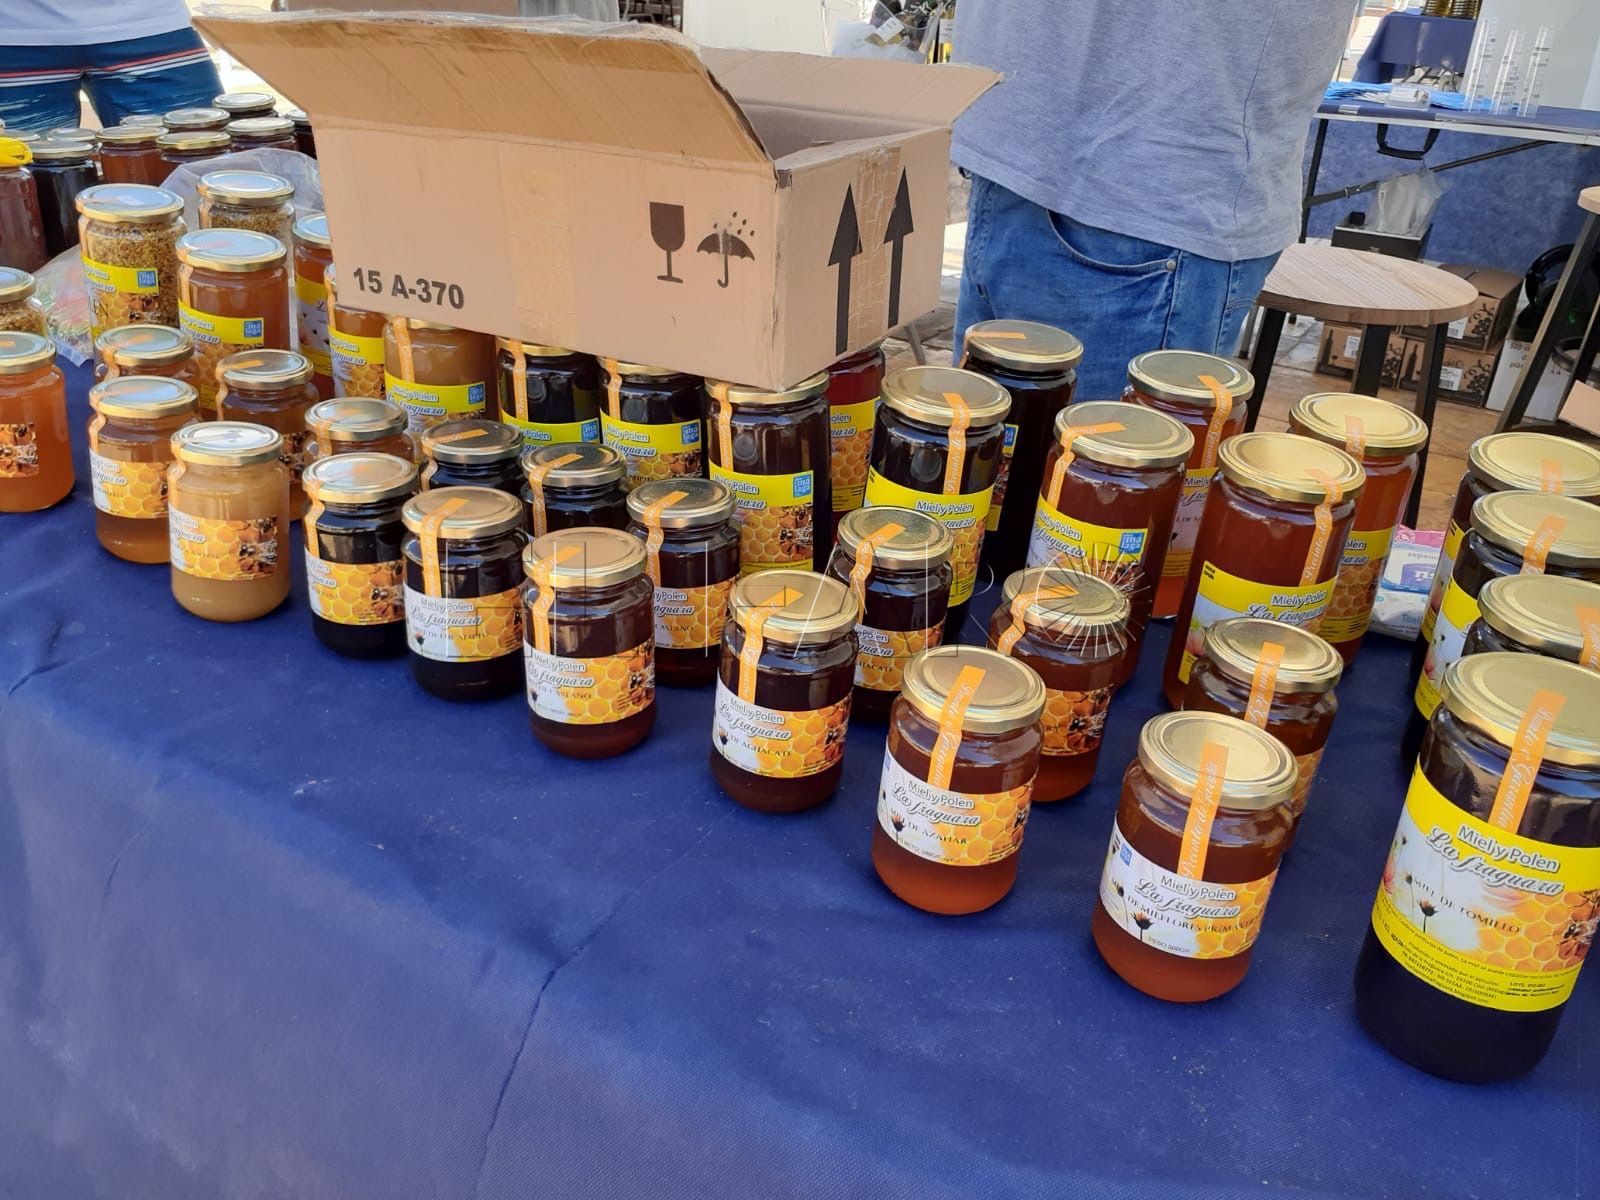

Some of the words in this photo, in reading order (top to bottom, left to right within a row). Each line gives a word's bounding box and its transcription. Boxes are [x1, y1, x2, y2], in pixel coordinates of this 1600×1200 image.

[353, 267, 383, 294] 15
[391, 274, 465, 310] A-370
[413, 393, 438, 402] Polen
[831, 414, 850, 423] olen
[526, 430, 550, 440] Polen
[624, 432, 649, 443] Polen
[1185, 477, 1202, 486] Miel
[733, 483, 758, 494] Polen
[917, 501, 938, 511] Miel
[949, 504, 972, 514] Polen
[1056, 521, 1080, 540] Polen
[1344, 541, 1365, 549] olen
[662, 592, 687, 601] Polen
[1272, 595, 1295, 606] Miel
[447, 602, 473, 612] Polen
[654, 606, 694, 617] aguara
[559, 660, 585, 672] Polen
[538, 671, 594, 689] fraguara
[755, 711, 783, 724] Polen
[731, 717, 790, 740] fraguara
[909, 780, 931, 798] Miel
[941, 794, 973, 809] Polen
[892, 782, 911, 807] La
[909, 802, 979, 827] fraguara
[923, 830, 968, 845] AZAHAR
[1458, 825, 1492, 851] Miel
[1508, 847, 1558, 871] Polen
[1429, 828, 1458, 860] La
[1452, 854, 1563, 893] fraguara
[1161, 875, 1187, 893] Miel
[1201, 888, 1235, 900] Polen
[1135, 878, 1159, 904] La
[1158, 894, 1239, 918] fraguara
[1411, 878, 1436, 897] MIEL
[1440, 896, 1454, 908] DE
[1460, 906, 1520, 933] TOMILLO
